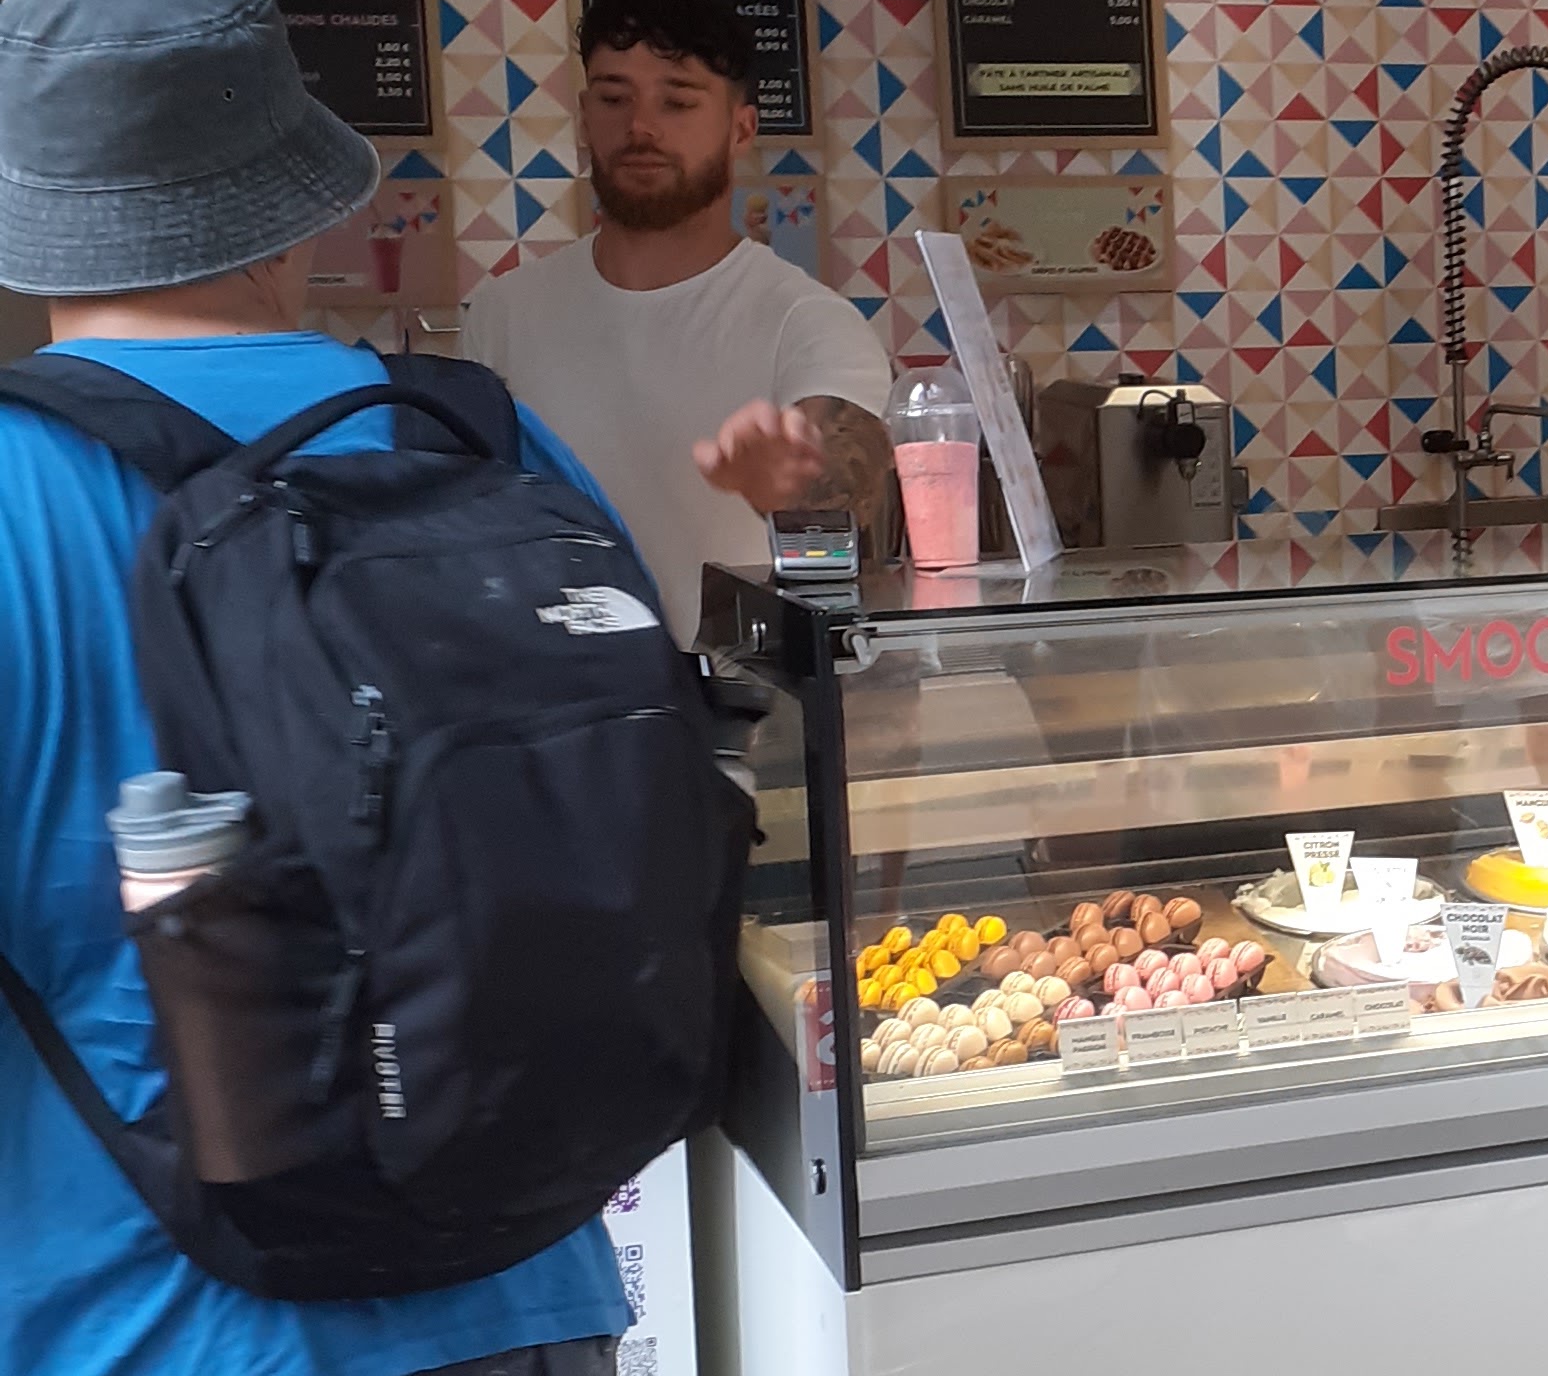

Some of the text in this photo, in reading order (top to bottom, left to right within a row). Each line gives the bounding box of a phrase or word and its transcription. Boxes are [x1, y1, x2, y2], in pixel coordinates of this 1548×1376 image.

[1303, 841, 1340, 850] CITRON
[1446, 913, 1504, 924] CHOCOLAT
[1462, 924, 1489, 933] NOIR
